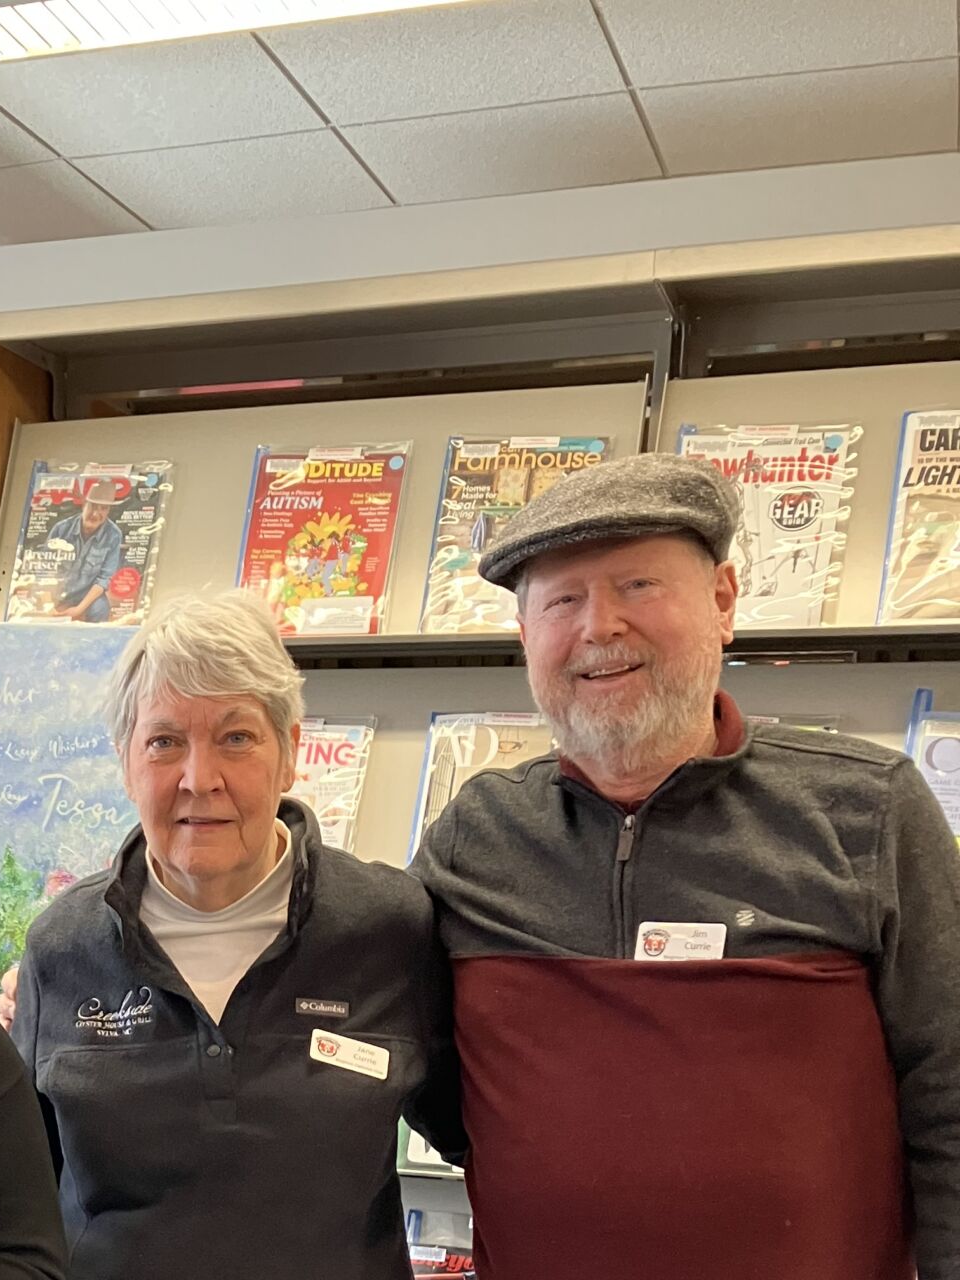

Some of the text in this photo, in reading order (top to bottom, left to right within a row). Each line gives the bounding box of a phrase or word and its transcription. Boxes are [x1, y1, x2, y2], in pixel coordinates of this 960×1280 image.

[454, 448, 602, 471] Farmhouse
[686, 448, 840, 484] owhunter
[451, 485, 462, 499] 7
[260, 497, 324, 510] AUTISM
[769, 499, 824, 519] GEAR
[39, 773, 132, 832] Tessa
[691, 930, 708, 938] Jim
[684, 941, 711, 951] Currie
[309, 1002, 345, 1014] Columbia
[353, 1054, 377, 1065] Currie
